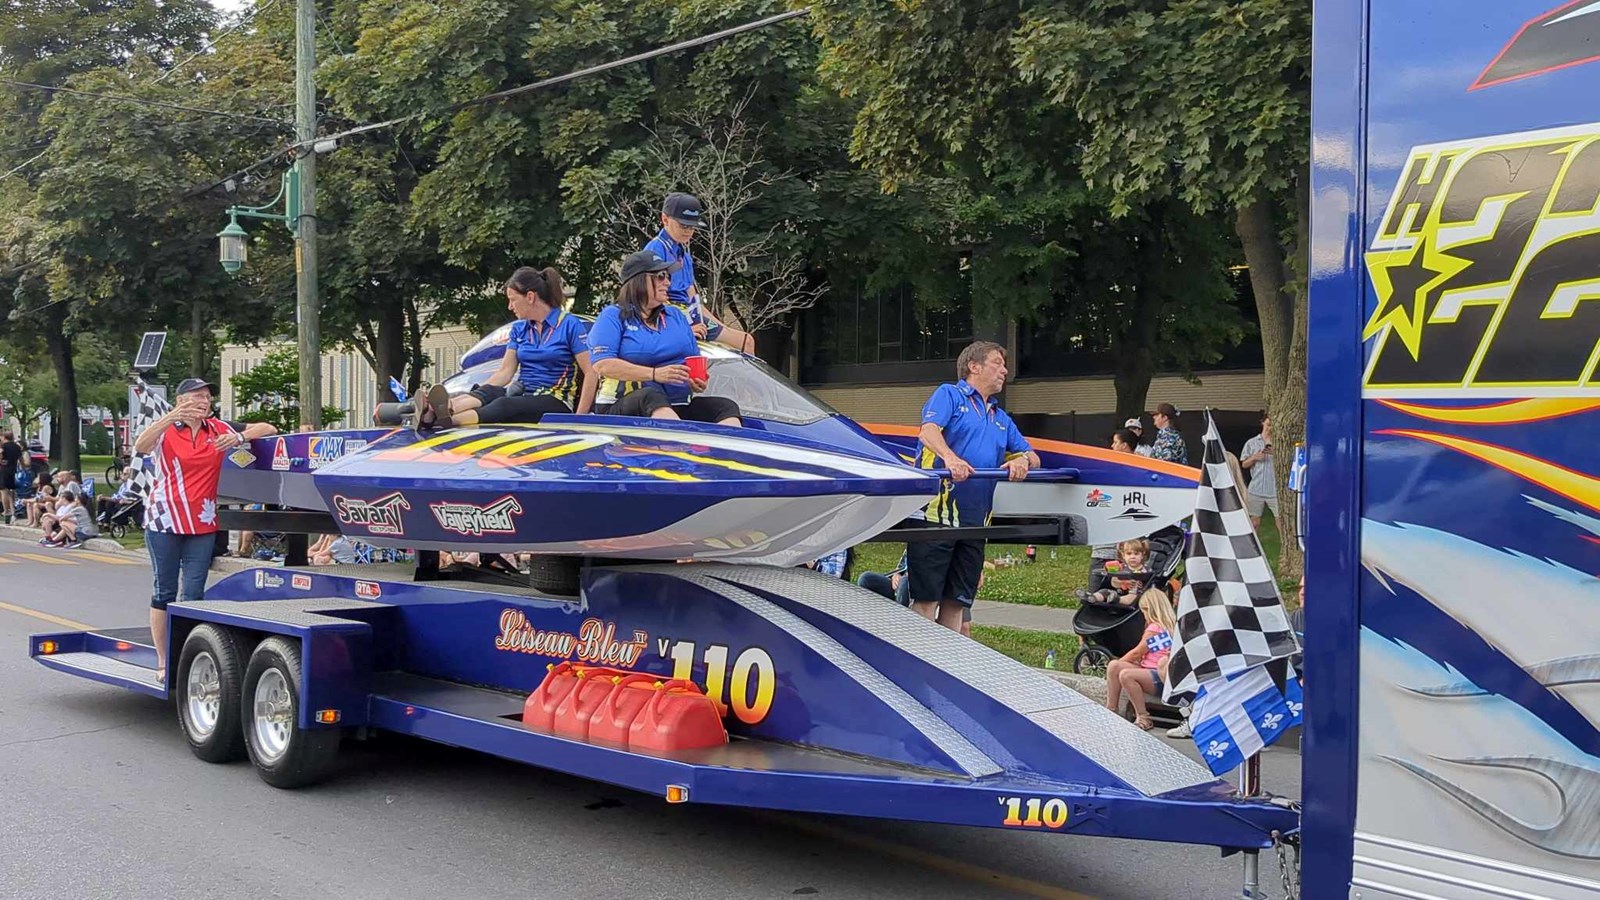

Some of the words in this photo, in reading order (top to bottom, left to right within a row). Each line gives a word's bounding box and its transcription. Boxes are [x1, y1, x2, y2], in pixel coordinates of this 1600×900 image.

[335, 495, 404, 533] Savary
[433, 499, 514, 533] Valleyfield
[1123, 491, 1150, 507] HRL
[357, 582, 371, 595] RTA
[576, 617, 639, 667] Bleu
